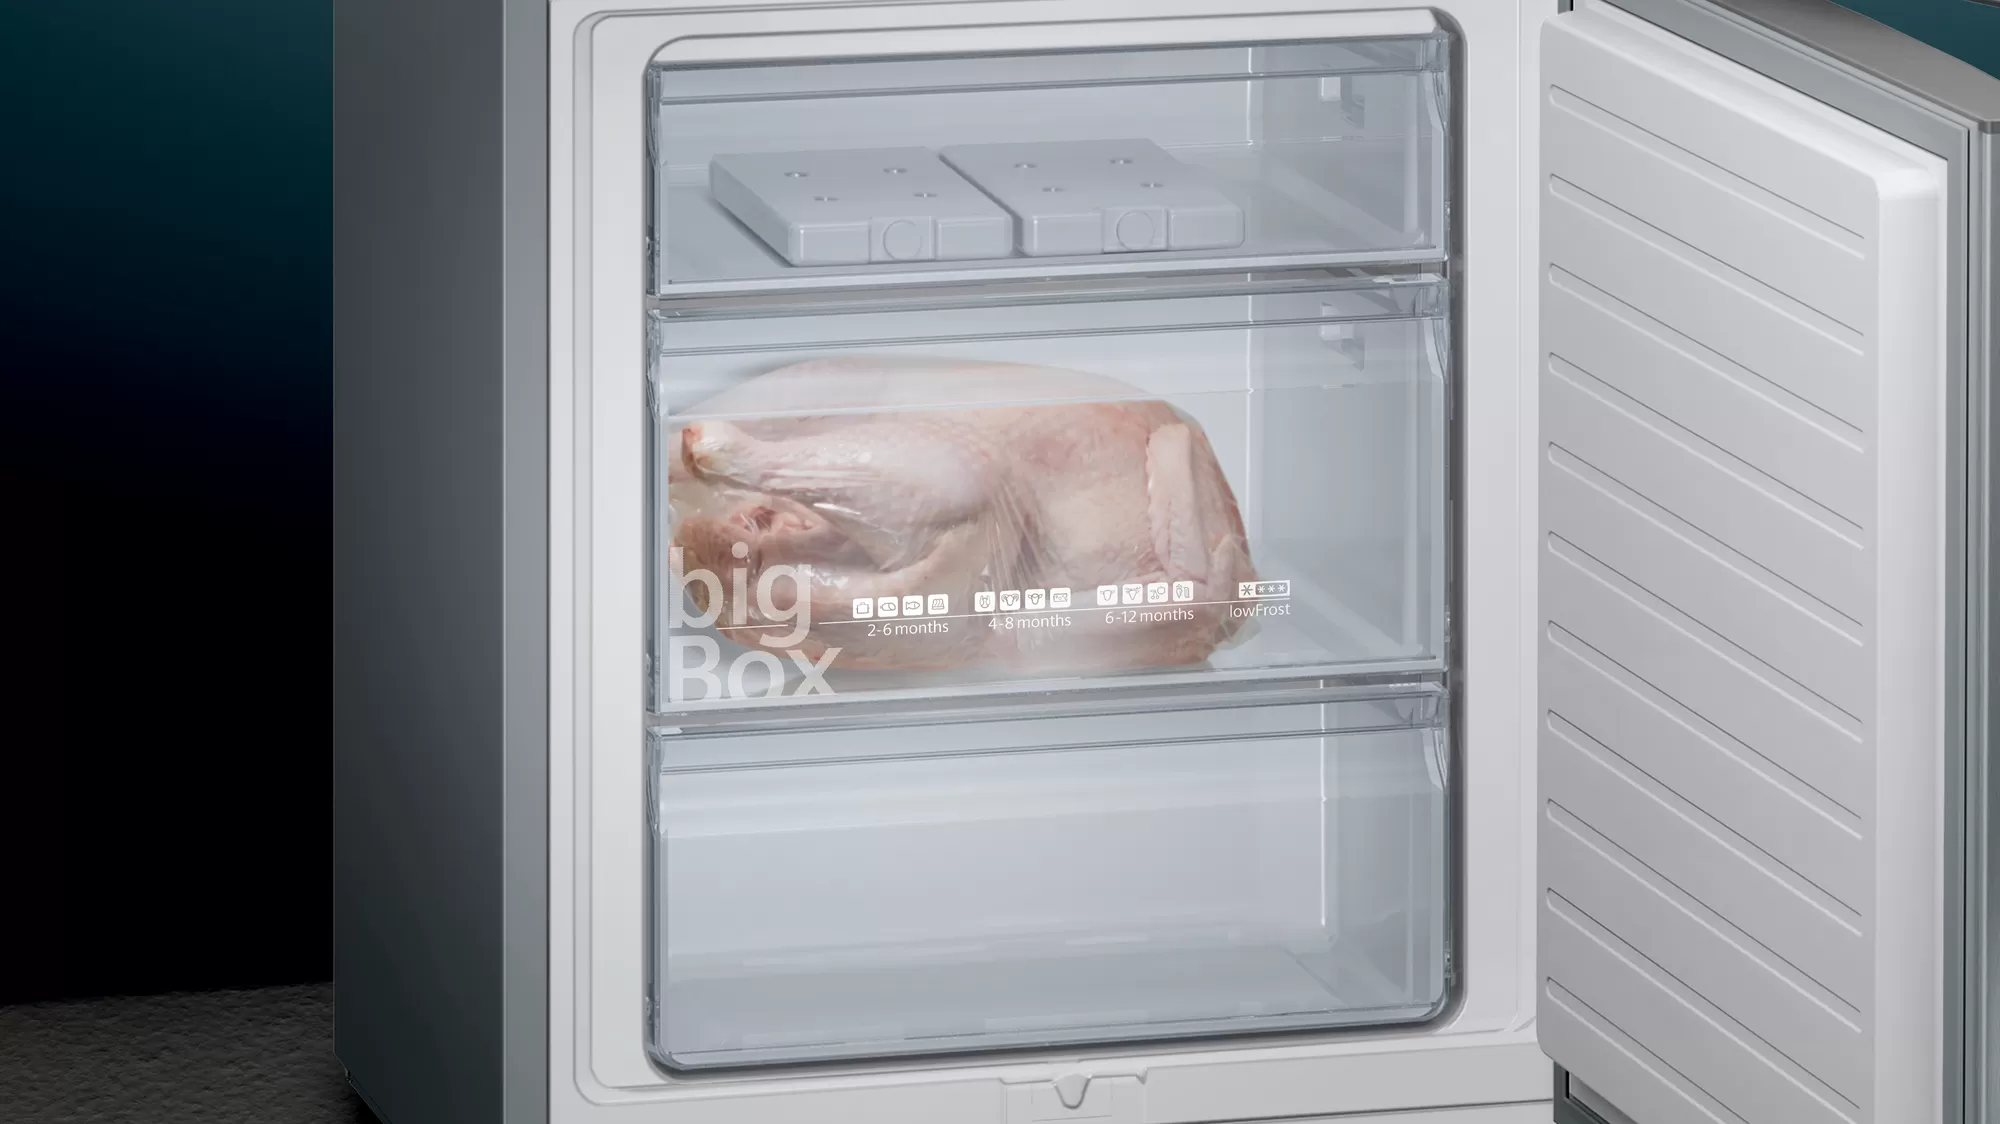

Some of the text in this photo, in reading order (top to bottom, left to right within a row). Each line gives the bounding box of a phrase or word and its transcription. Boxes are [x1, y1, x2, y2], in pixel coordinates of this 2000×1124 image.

[668, 542, 812, 648] big
[1105, 608, 1195, 624] 6-12 months
[1229, 603, 1291, 618] lowFrost
[867, 620, 949, 637] 2-6 months
[988, 613, 1072, 631] 4-8 months
[668, 634, 843, 703] Box
